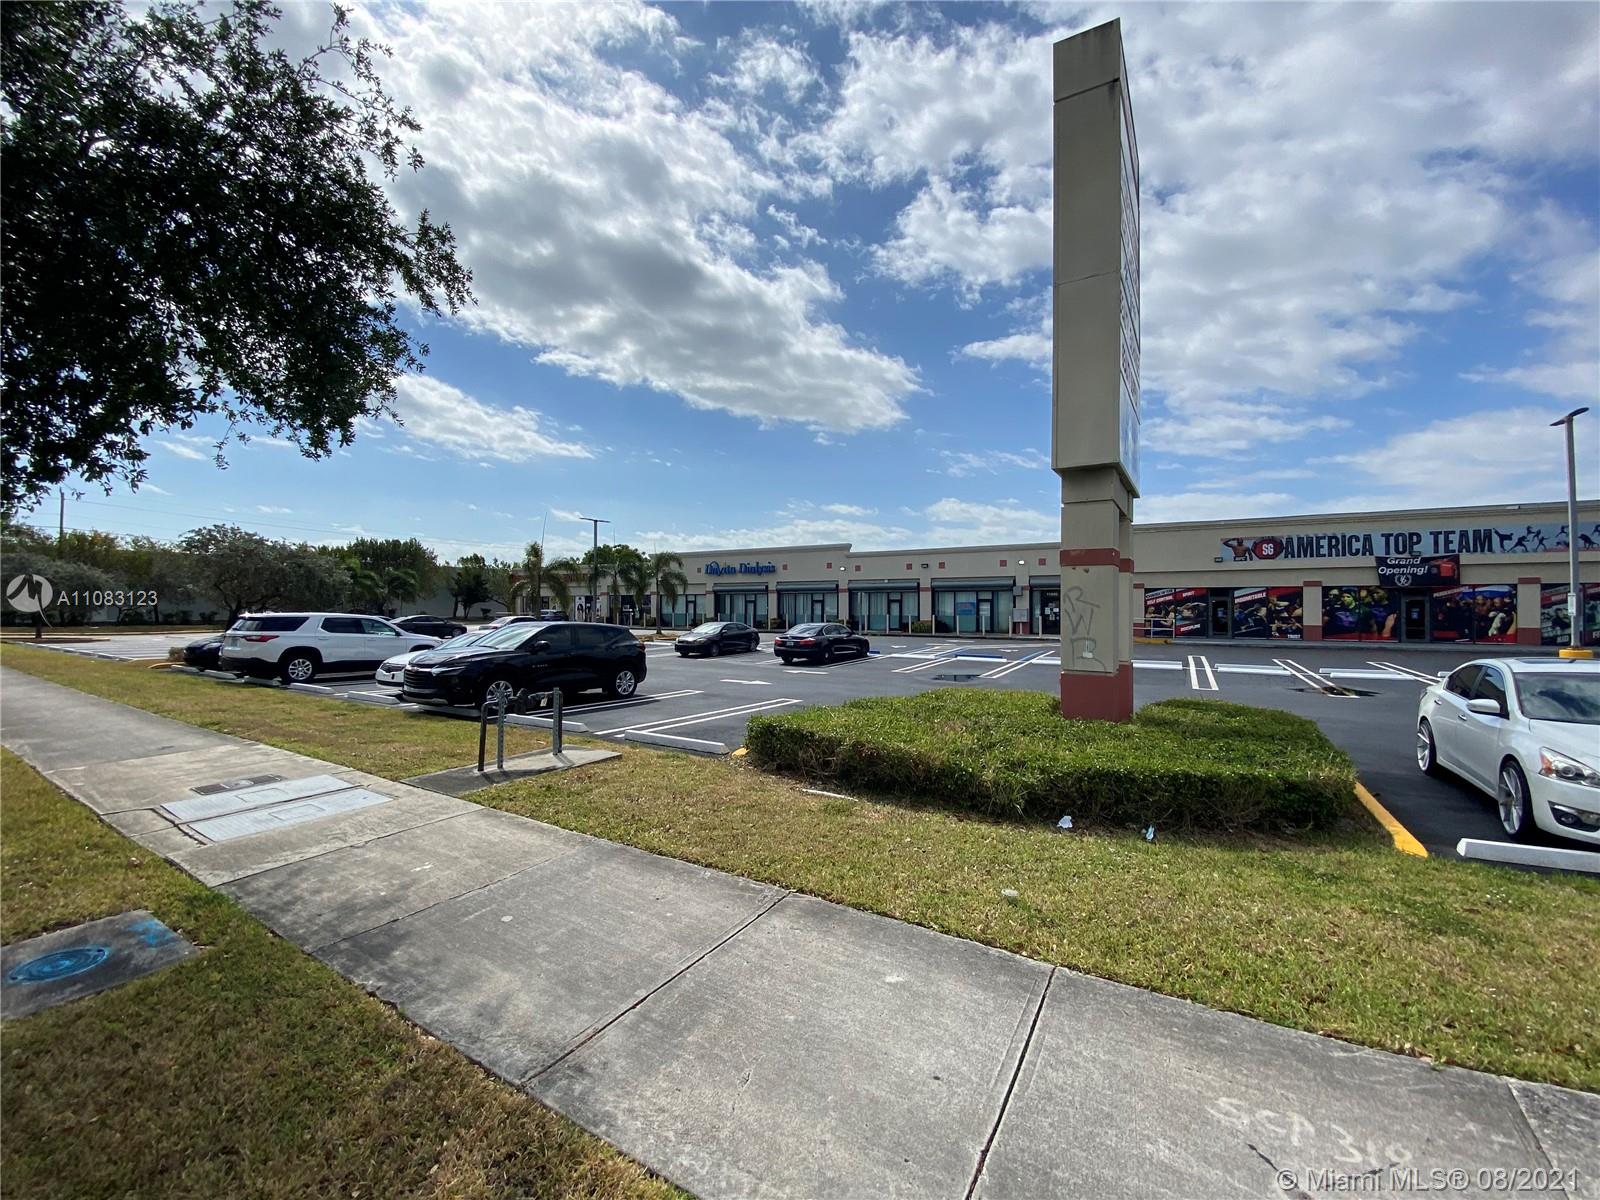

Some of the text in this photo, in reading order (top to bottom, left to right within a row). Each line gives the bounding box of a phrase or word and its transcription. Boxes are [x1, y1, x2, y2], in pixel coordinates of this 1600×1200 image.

[1284, 528, 1494, 558] AMERICA TOP TEAM
[1387, 557, 1421, 565] Grand
[1378, 565, 1428, 575] Opening!
